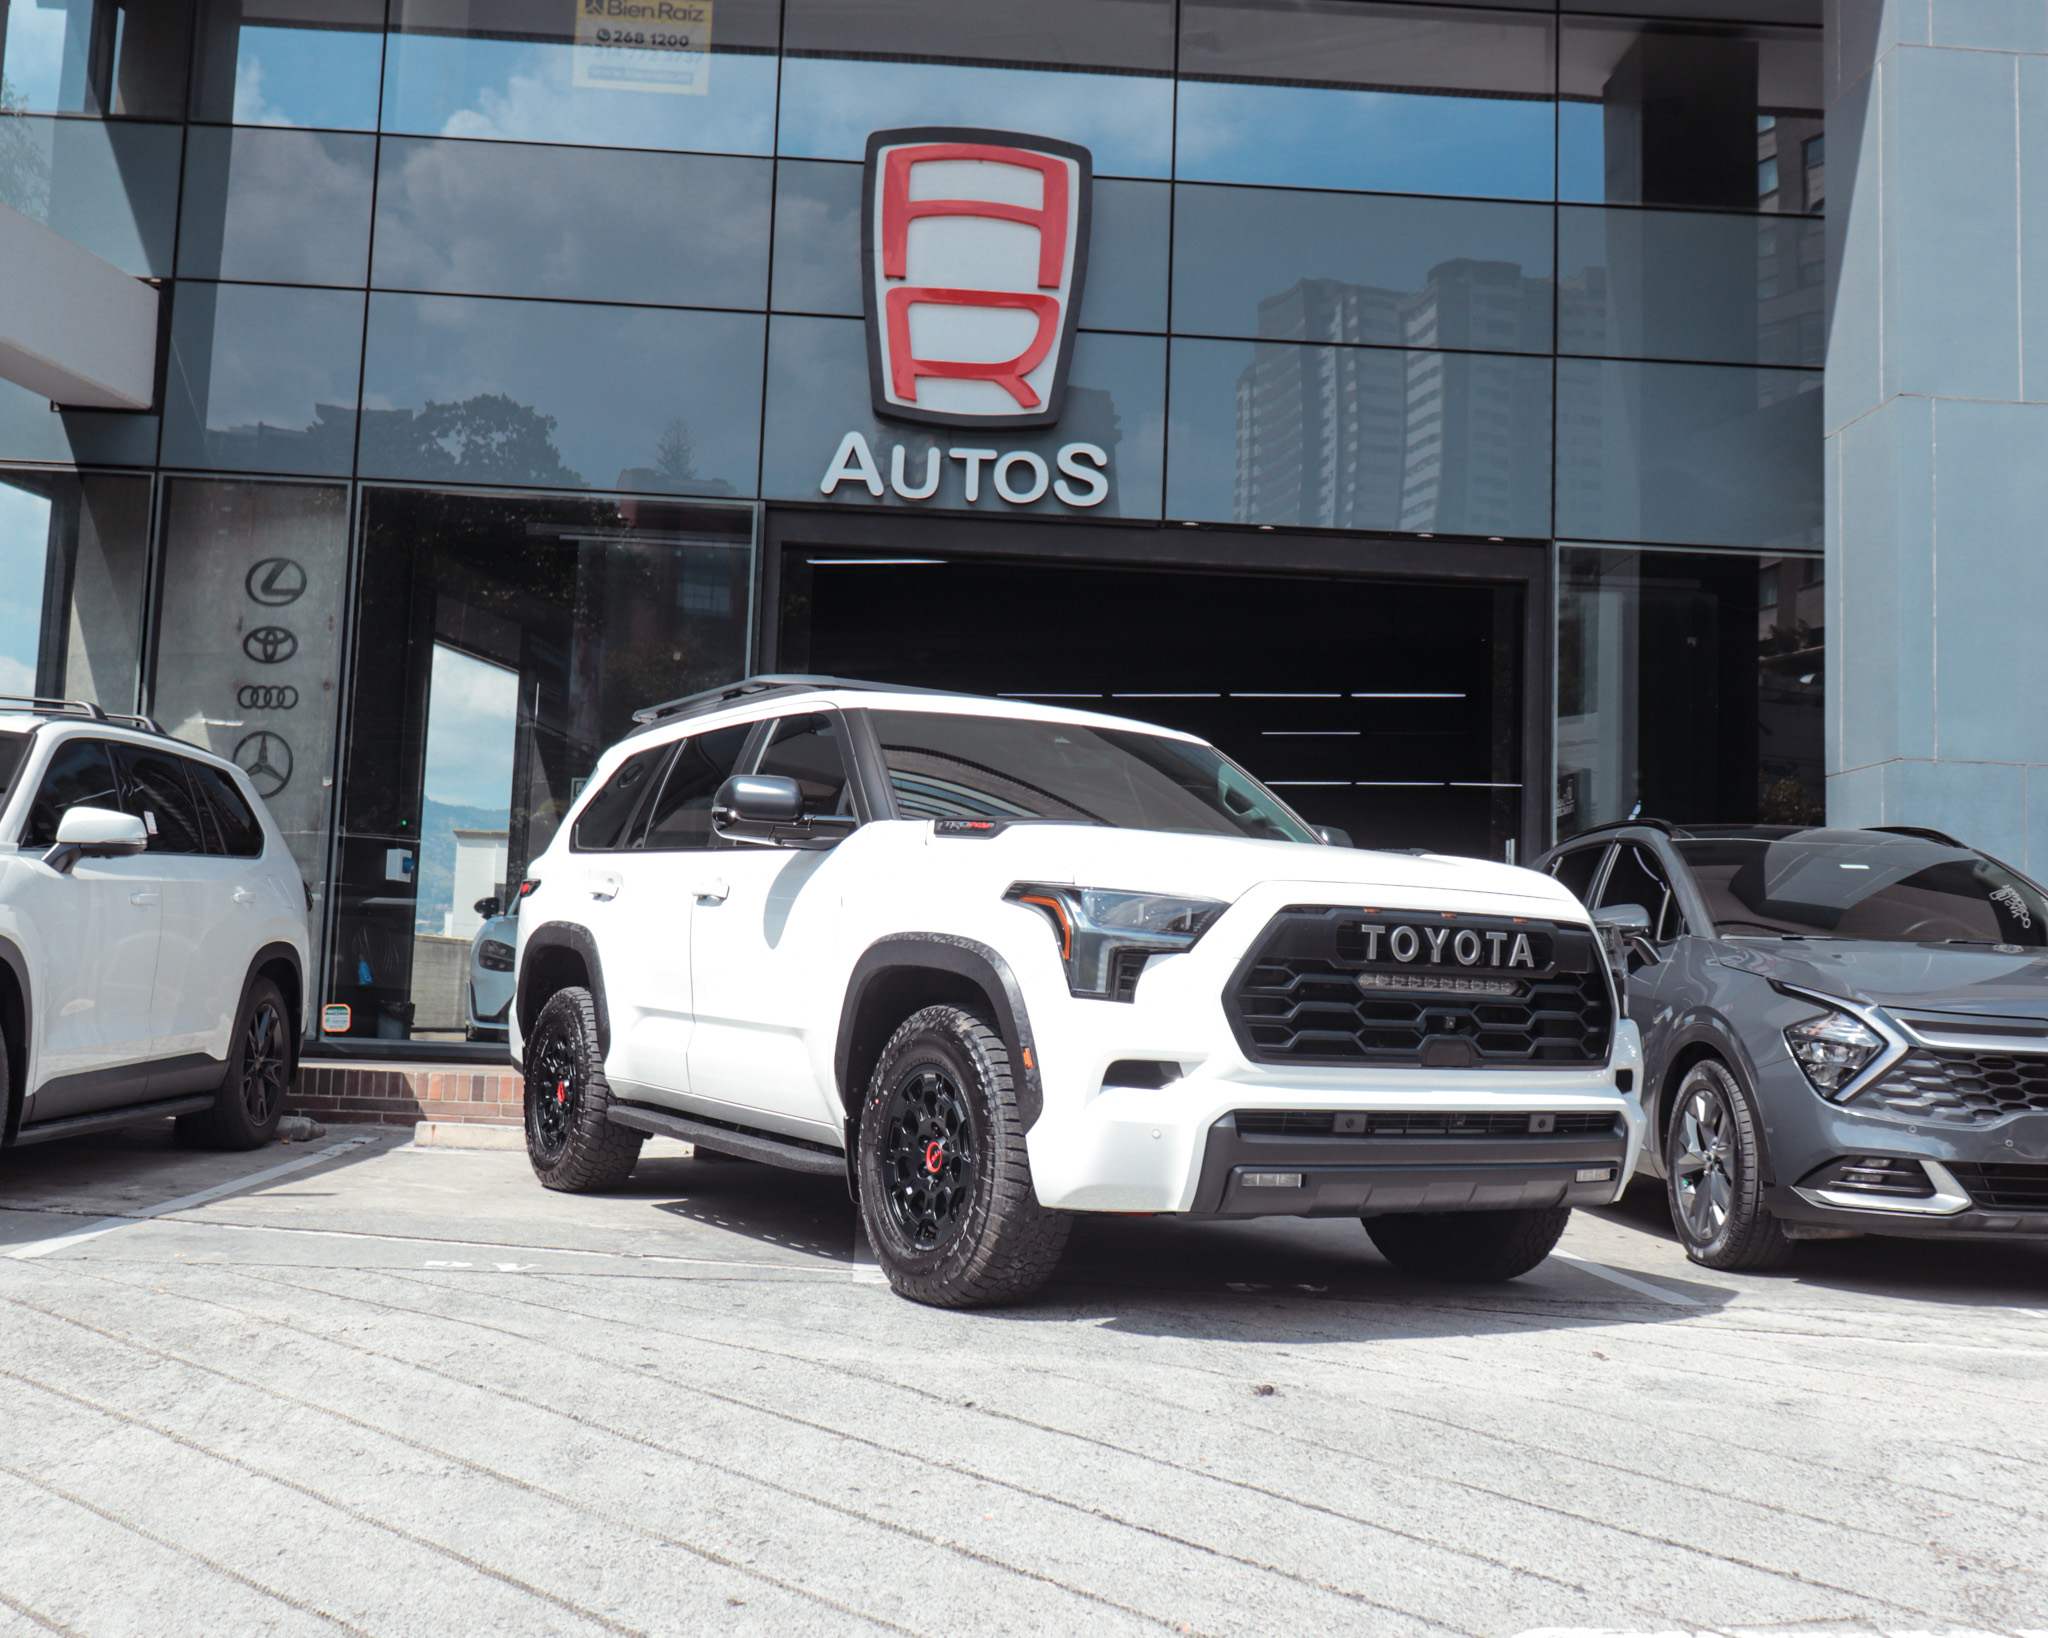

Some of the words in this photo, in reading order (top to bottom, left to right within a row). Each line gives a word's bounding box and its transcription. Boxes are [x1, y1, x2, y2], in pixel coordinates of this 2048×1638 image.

[607, 0, 655, 18] Bien
[613, 30, 645, 44] 268
[650, 33, 690, 47] 1200
[820, 431, 1109, 507] AUTOS
[1361, 923, 1535, 968] TOYOTA
